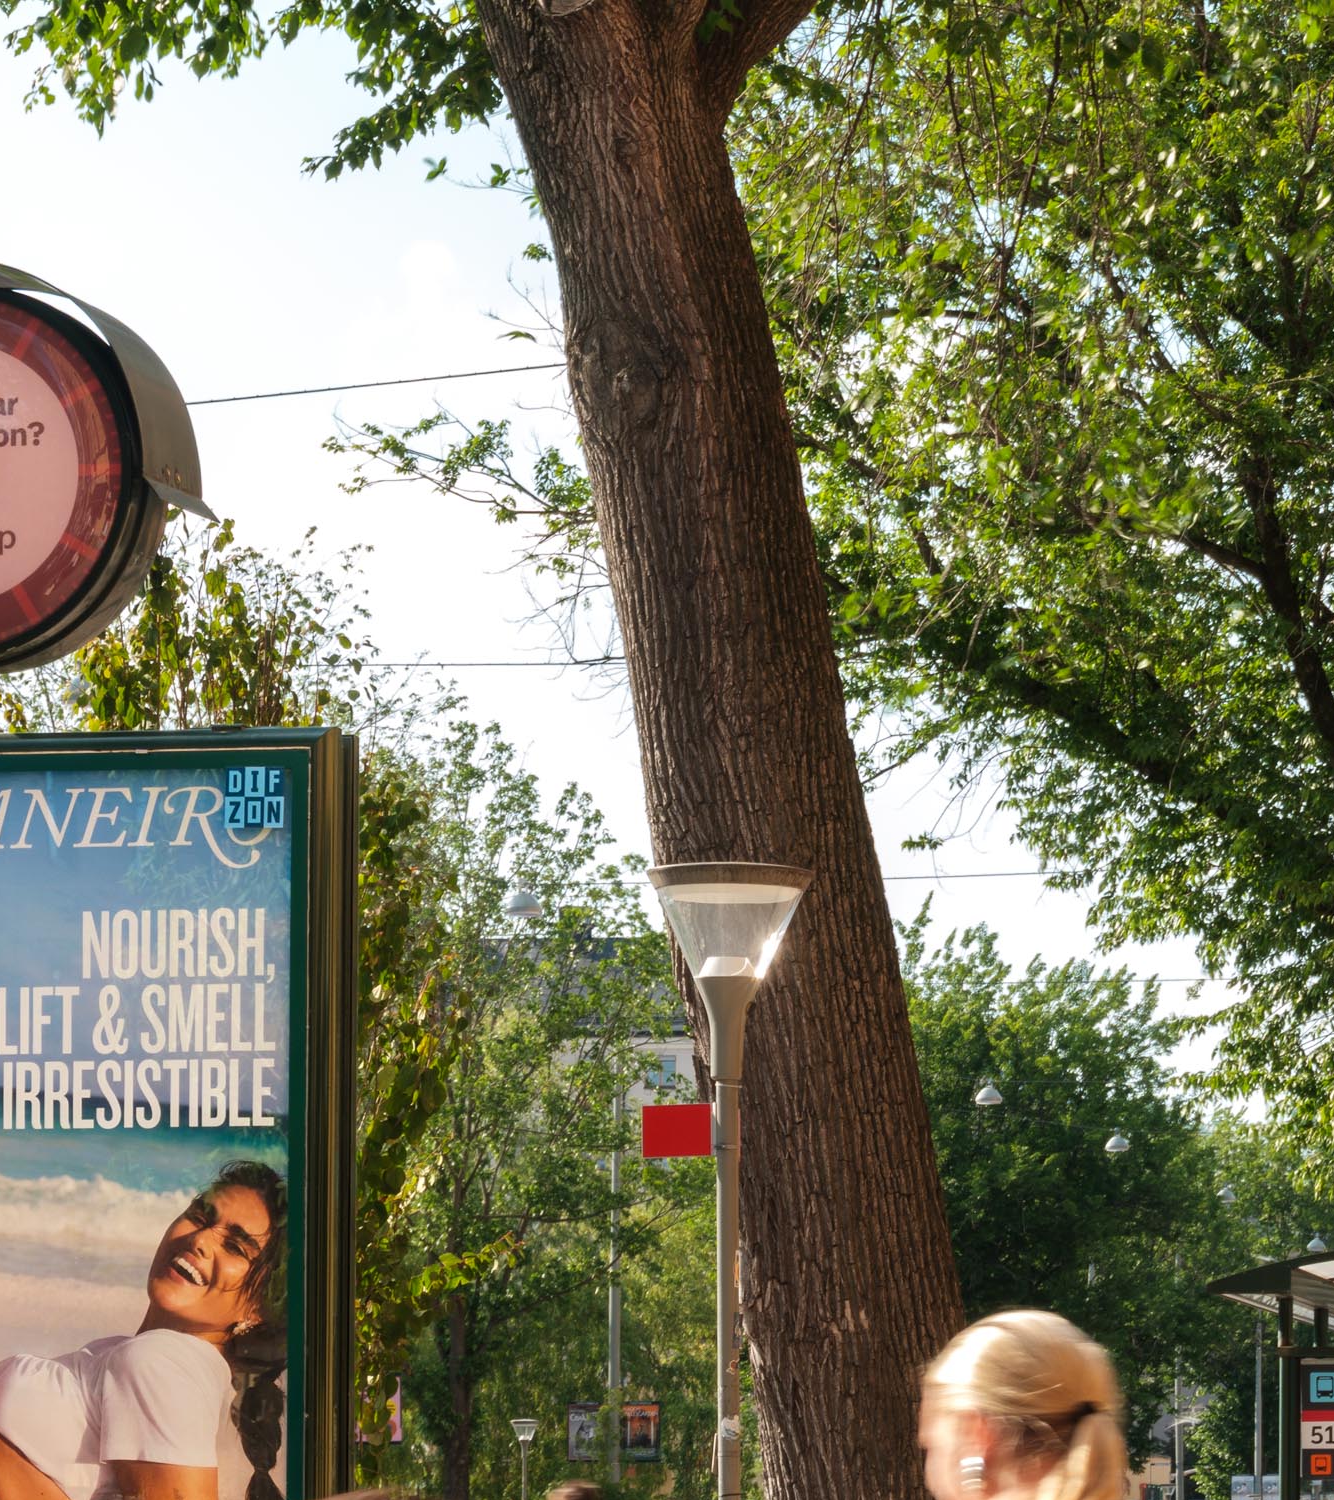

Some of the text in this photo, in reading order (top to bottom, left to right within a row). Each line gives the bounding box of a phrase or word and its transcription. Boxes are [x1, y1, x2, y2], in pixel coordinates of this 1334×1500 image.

[229, 770, 280, 793] DIF
[82, 907, 275, 984] NOURISH,
[92, 984, 129, 1056] &
[140, 981, 277, 1055] SMELL
[2, 1057, 276, 1131] IRRESISTIBLE
